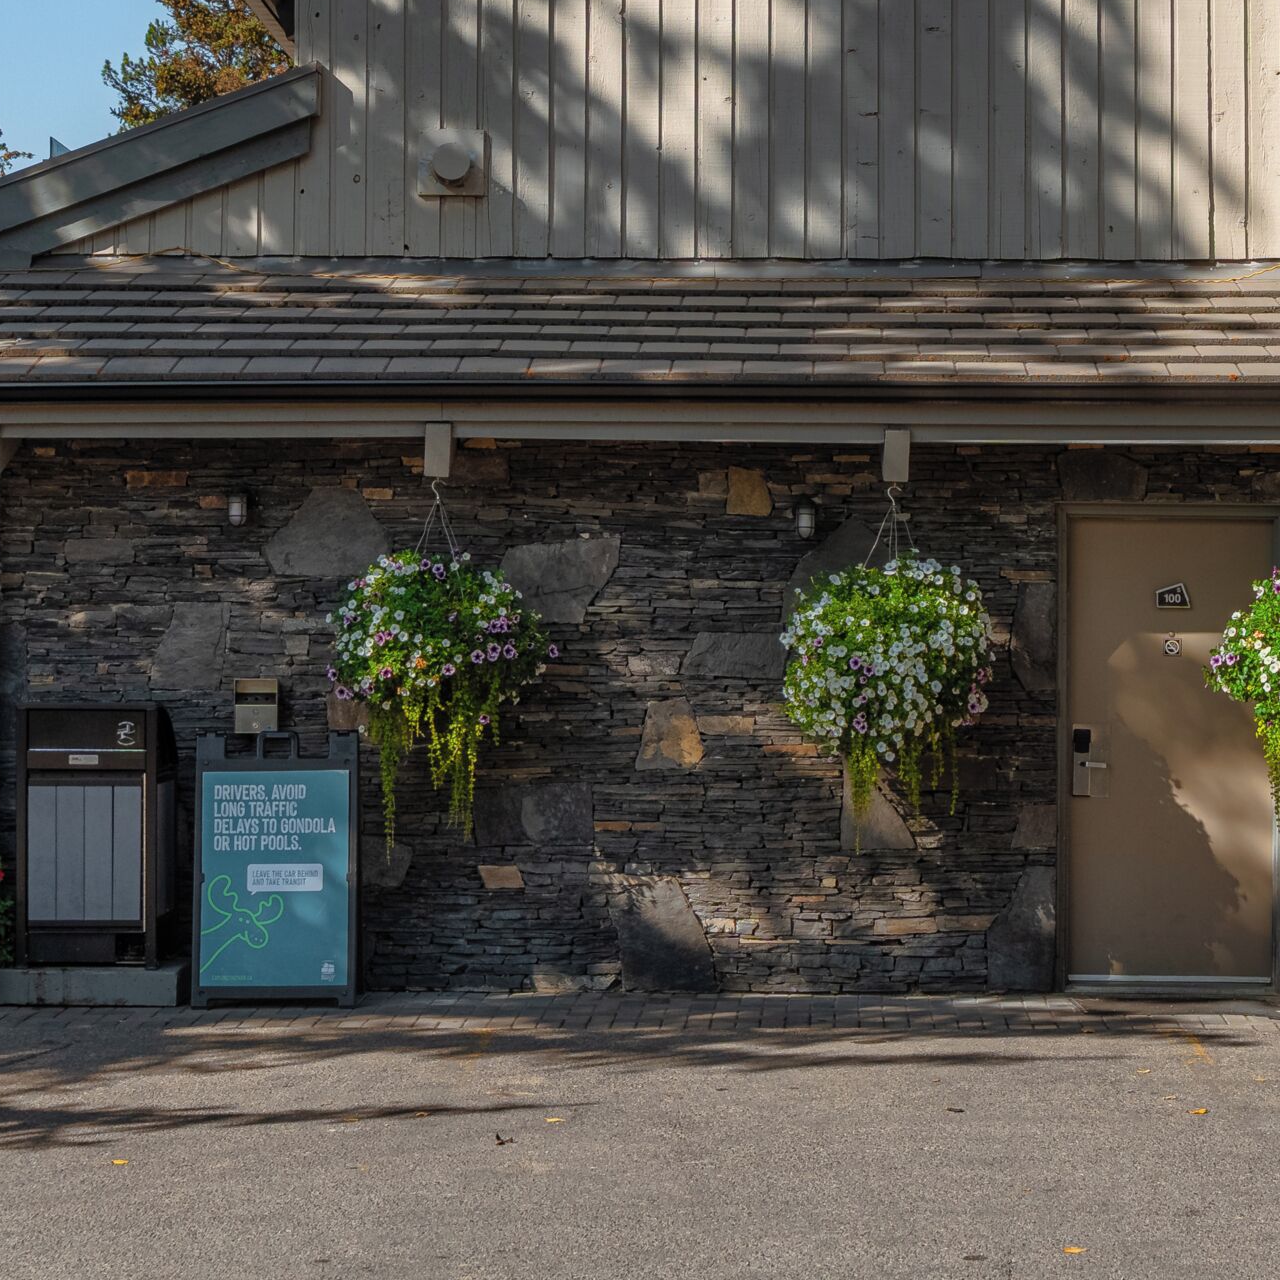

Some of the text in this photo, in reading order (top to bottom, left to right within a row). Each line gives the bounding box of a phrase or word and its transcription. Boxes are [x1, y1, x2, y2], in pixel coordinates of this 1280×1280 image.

[1163, 593, 1181, 603] 100
[214, 784, 306, 800] DRIVERS, AVOID
[214, 801, 297, 817] LONG TRAFFIC
[214, 818, 336, 834] DELAYS TO GONDOLA
[214, 835, 302, 851] OR HOT POOLS.
[252, 870, 270, 878] LEAVE
[252, 878, 264, 886] AND
[266, 878, 280, 886] TAKE
